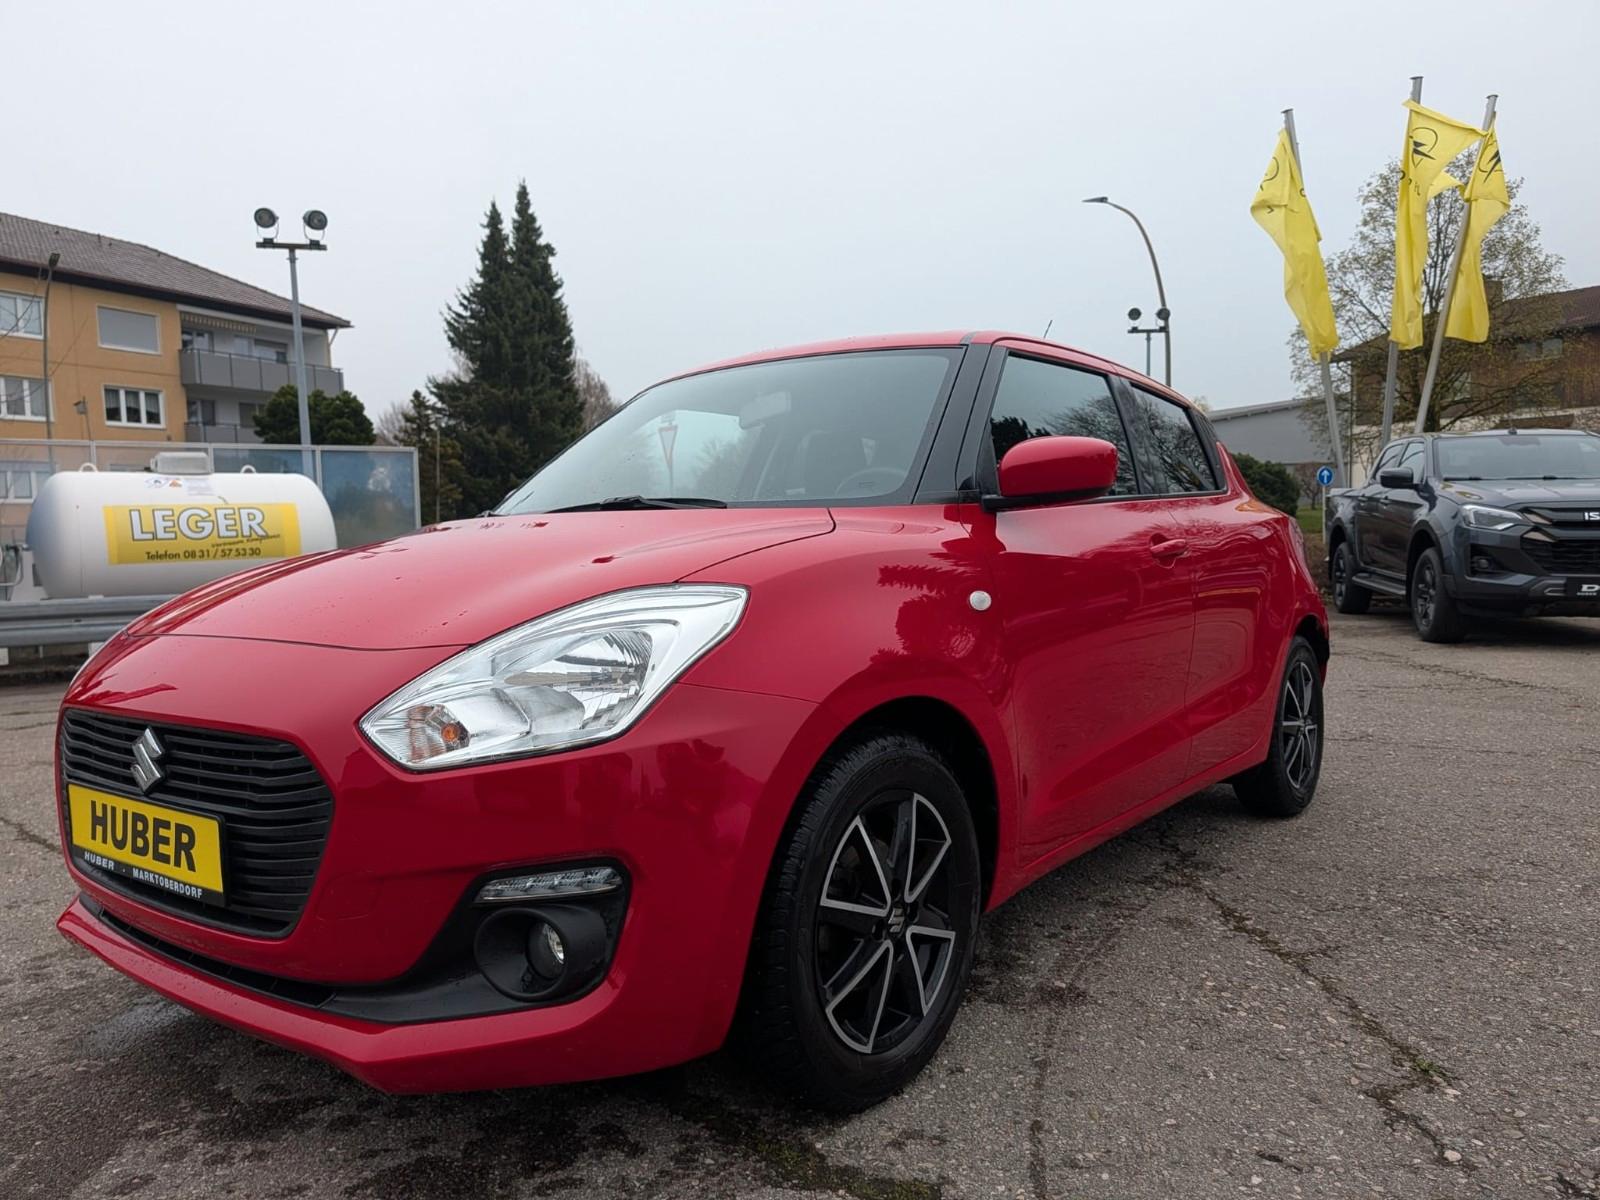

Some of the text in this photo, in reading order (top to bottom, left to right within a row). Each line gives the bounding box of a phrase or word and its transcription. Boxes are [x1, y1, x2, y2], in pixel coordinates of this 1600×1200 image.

[129, 507, 269, 541] LEGER
[145, 550, 181, 561] Telefon
[91, 800, 196, 872] HUBER
[84, 852, 203, 899] HUBER MARKTOBERDORF
